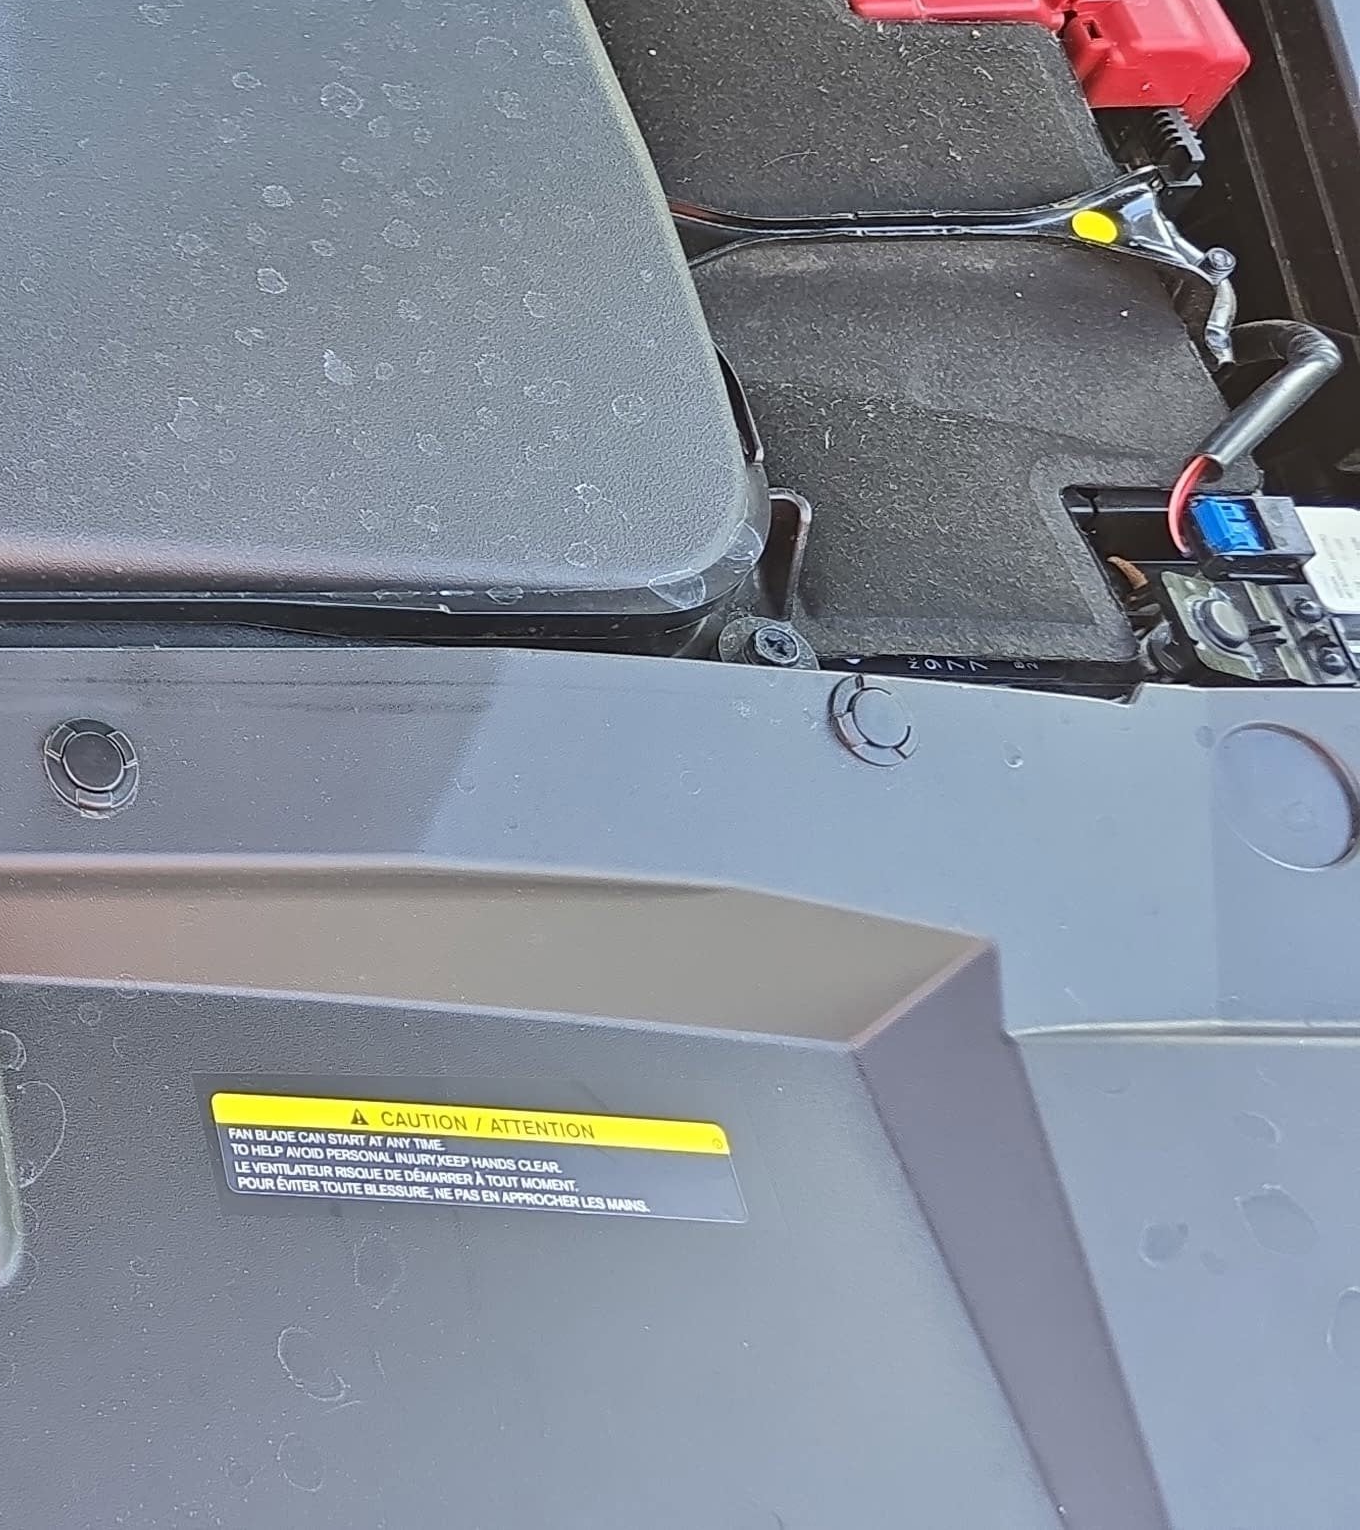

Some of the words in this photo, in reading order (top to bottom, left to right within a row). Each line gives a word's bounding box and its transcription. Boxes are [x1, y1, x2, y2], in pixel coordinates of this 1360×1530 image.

[229, 1128, 253, 1140] FAN
[255, 1130, 297, 1142] BLADE
[298, 1133, 325, 1144] CAN
[328, 1134, 365, 1146] START
[369, 1136, 384, 1147] AT
[386, 1137, 411, 1149] ANY
[381, 1111, 468, 1130] CAUTION
[490, 1118, 595, 1140] ATTENTION
[231, 1143, 249, 1155] TO
[252, 1146, 283, 1157] HELP
[286, 1147, 324, 1159] AVOID
[327, 1149, 394, 1163] PERSONAL
[472, 1157, 517, 1170] HANDS
[235, 1161, 250, 1173] LE
[252, 1162, 330, 1177] VENTILATEUR
[335, 1166, 381, 1180] RISQUE
[385, 1169, 402, 1181] DE
[405, 1167, 473, 1185] DÉMARRER
[485, 1175, 519, 1188] TOUT
[521, 1178, 579, 1192] MOMENT.
[239, 1177, 275, 1190] POUR
[277, 1176, 320, 1192] ÉVITER
[321, 1181, 363, 1194] TOUTE
[364, 1183, 434, 1200] BLESSURE,
[434, 1188, 453, 1200] NE
[454, 1189, 480, 1201] PAS
[482, 1190, 500, 1202] EN
[502, 1193, 580, 1208] APPROCHER
[581, 1196, 605, 1209] LES
